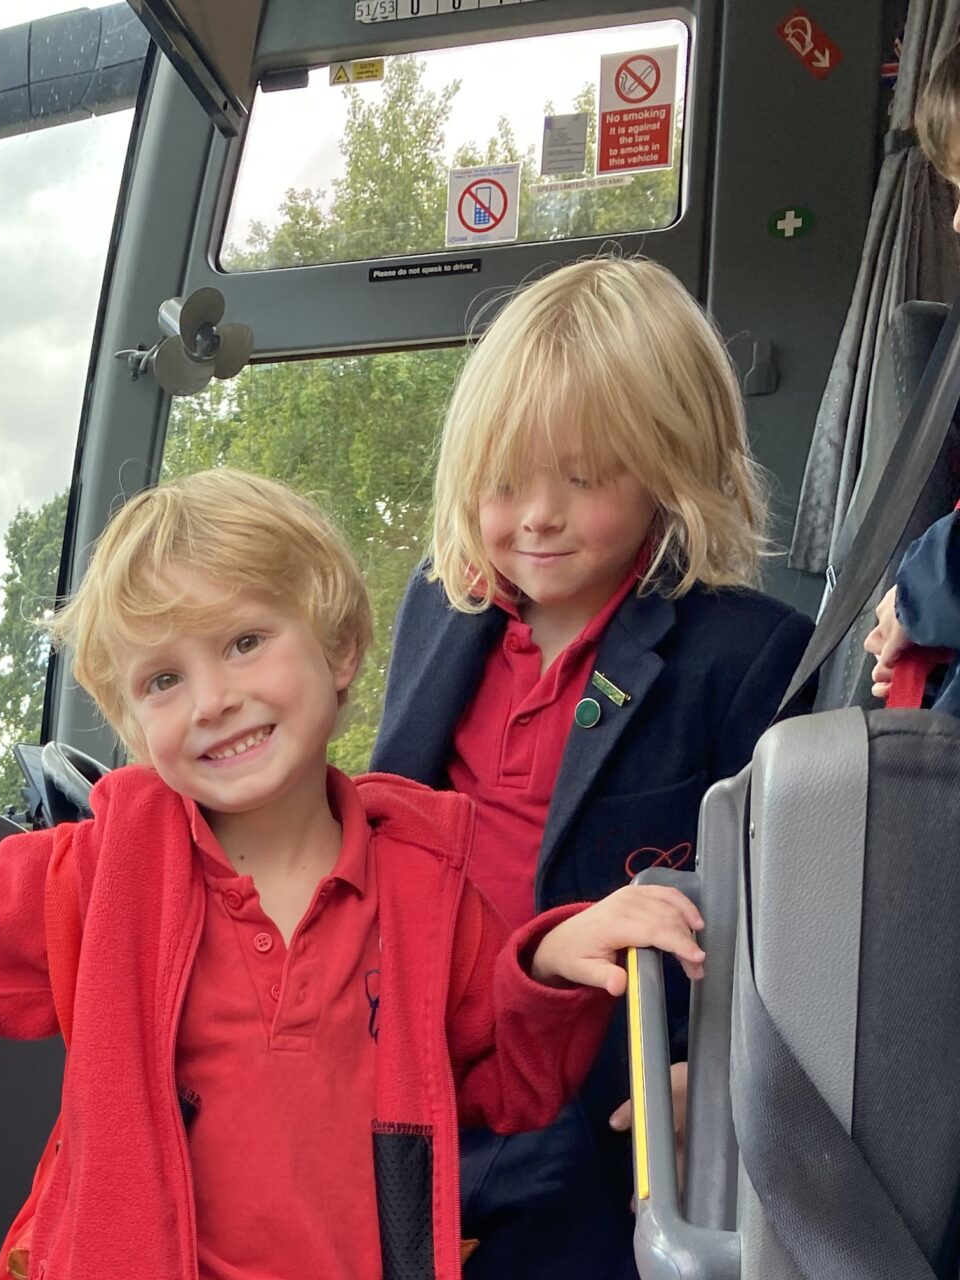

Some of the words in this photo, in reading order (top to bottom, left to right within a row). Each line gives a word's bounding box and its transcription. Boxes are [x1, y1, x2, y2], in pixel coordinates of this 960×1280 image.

[606, 113, 620, 124] No
[622, 108, 666, 122] smoking
[609, 127, 616, 135] It
[617, 126, 626, 134] is
[628, 121, 661, 134] against
[619, 136, 633, 144] the
[635, 134, 650, 142] law
[609, 147, 618, 156] to
[620, 144, 649, 155] smoke
[651, 142, 660, 151] in
[609, 157, 625, 167] this
[627, 153, 659, 165] vehicle
[373, 270, 396, 278] Please
[397, 268, 407, 276] do
[408, 267, 420, 275] not
[422, 265, 442, 274] speak
[453, 263, 474, 271] driver
